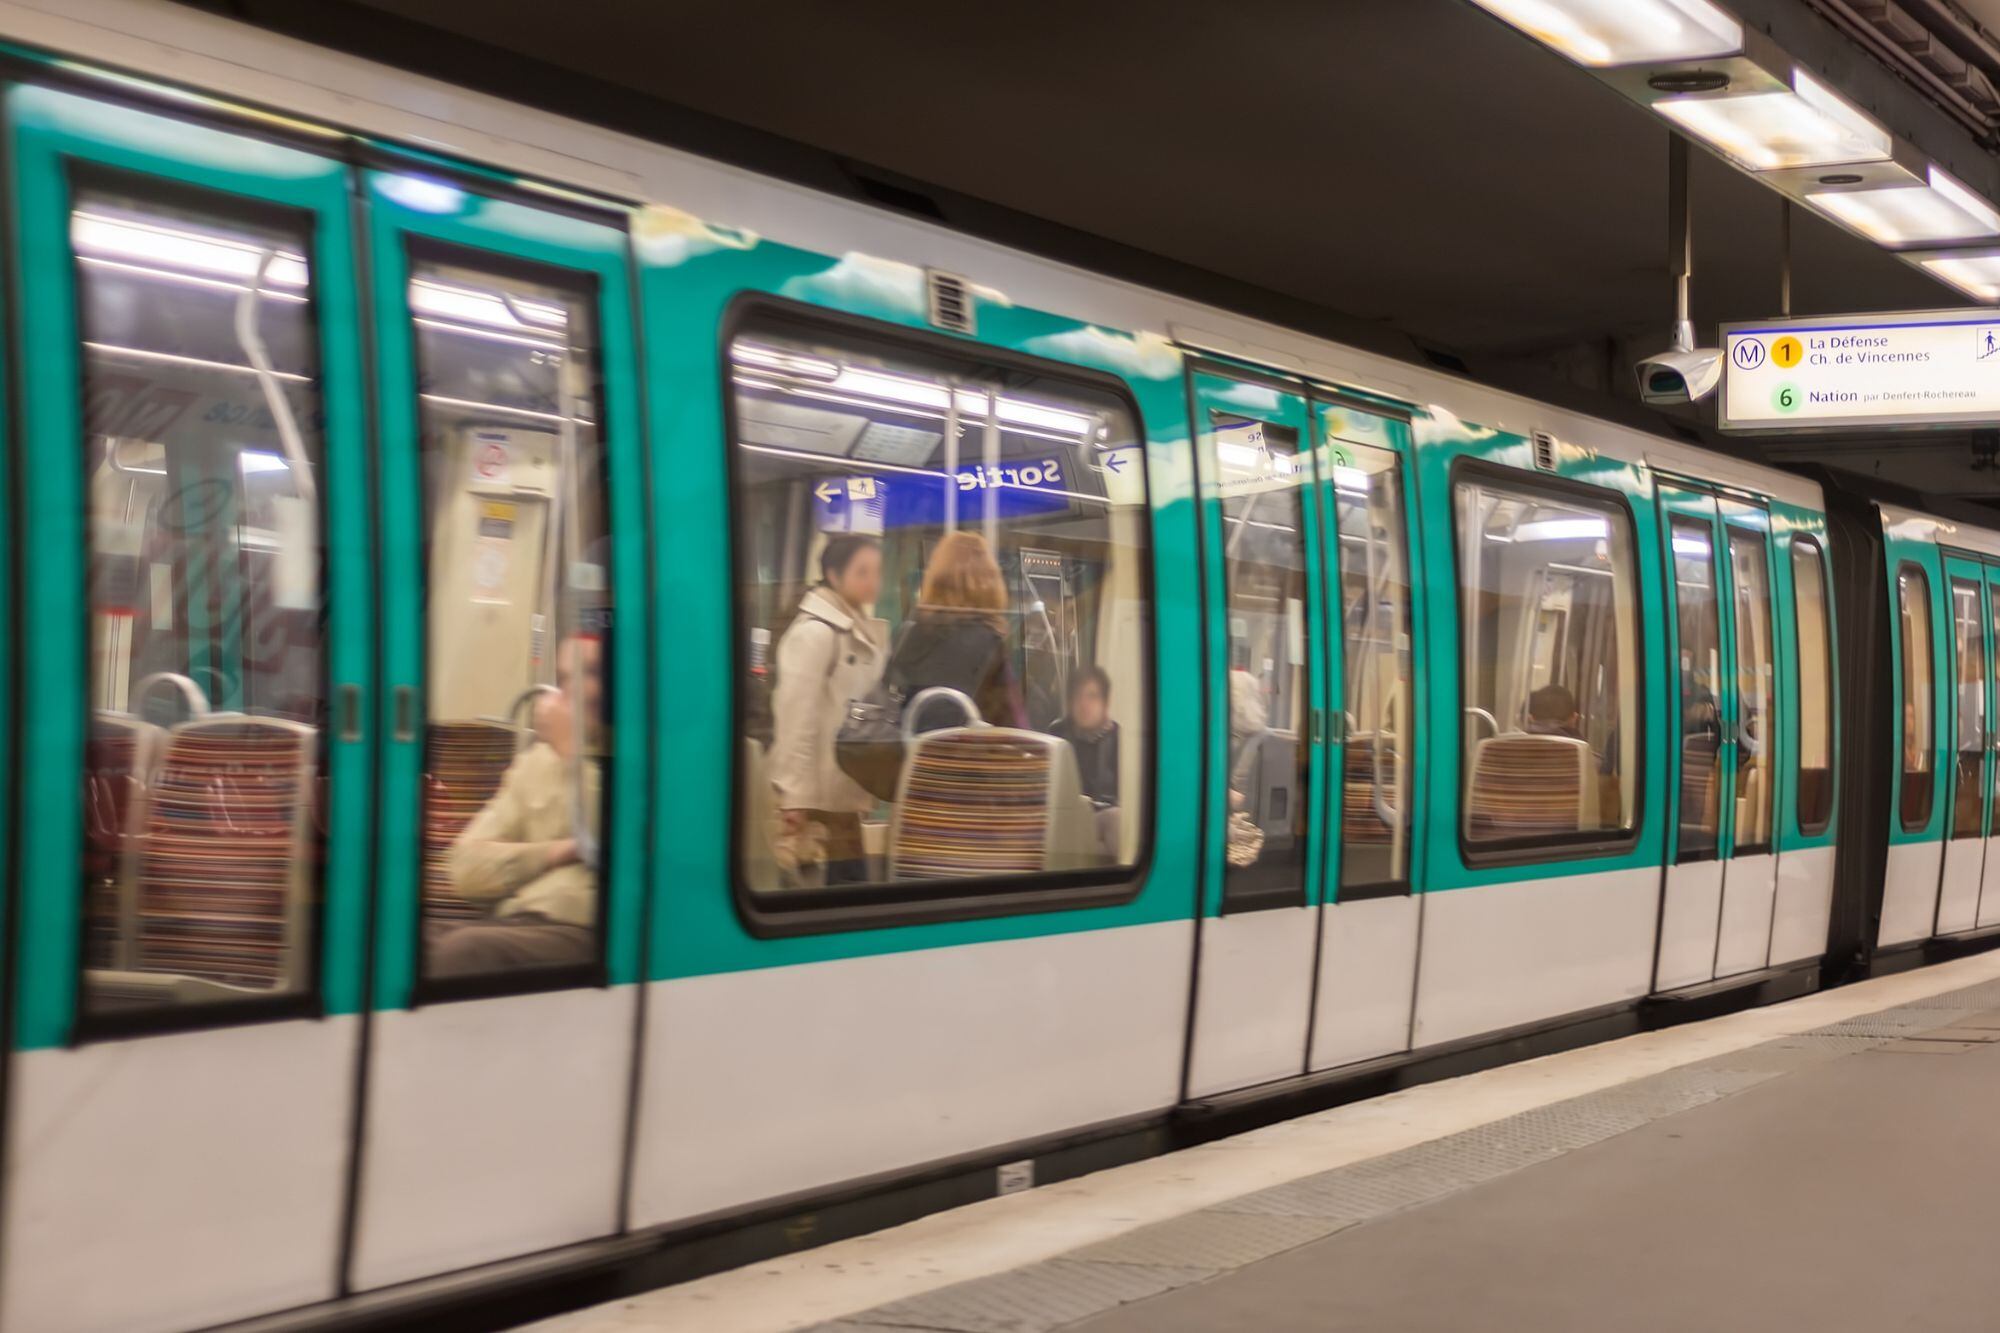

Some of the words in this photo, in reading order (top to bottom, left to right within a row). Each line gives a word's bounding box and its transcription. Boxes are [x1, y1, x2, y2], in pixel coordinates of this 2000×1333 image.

[1810, 338, 1825, 349] La
[1830, 336, 1888, 348] Défense
[1781, 343, 1790, 361] 1
[1810, 354, 1831, 365] Ch.
[1836, 353, 1852, 364] de
[1857, 351, 1930, 363] Vincennes
[1780, 388, 1793, 407] 6
[1809, 390, 1858, 403] Nation
[1863, 394, 1880, 402] par
